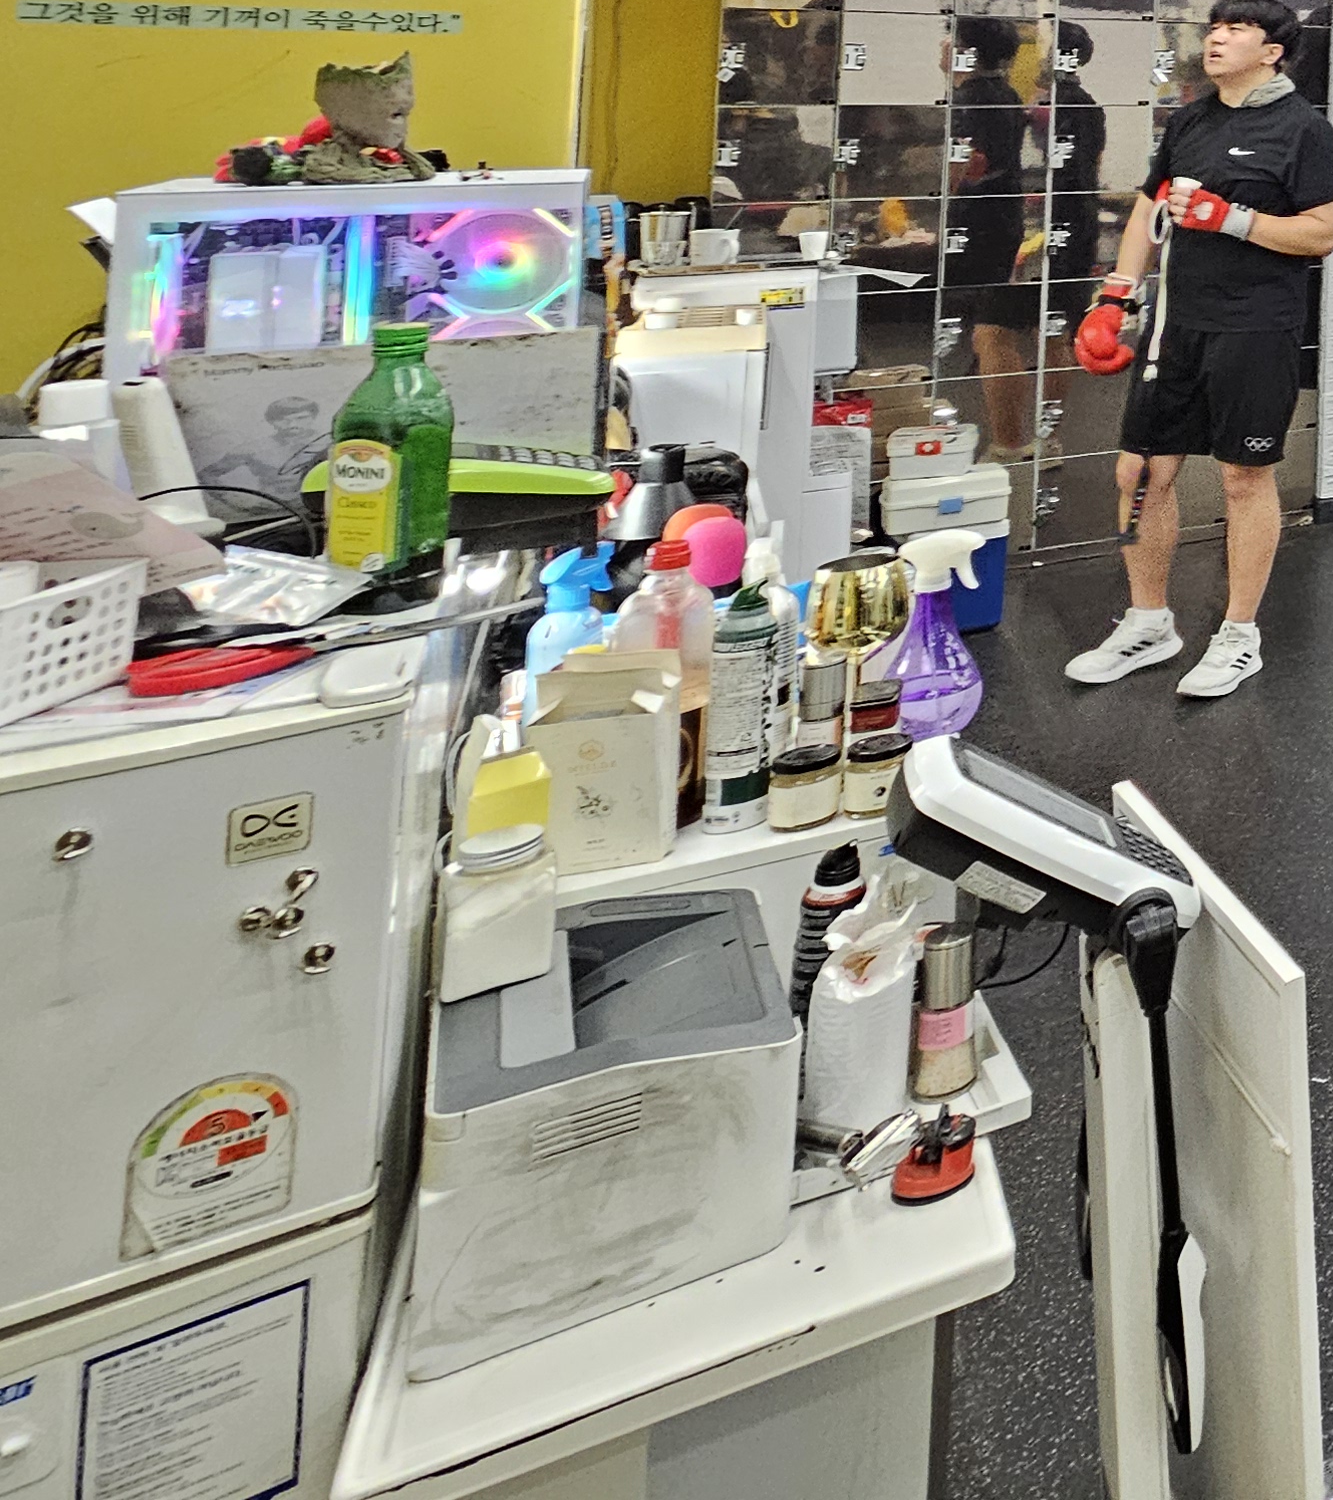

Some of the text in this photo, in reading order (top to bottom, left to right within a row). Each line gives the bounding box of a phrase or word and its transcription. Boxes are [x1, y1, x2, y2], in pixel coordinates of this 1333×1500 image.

[19, 2, 119, 25] 그것을
[131, 4, 191, 26] 위해
[205, 7, 290, 29] 기꺼이
[335, 463, 386, 480] MONINI
[234, 829, 303, 852] DAEWOO
[207, 1116, 226, 1137] 5
